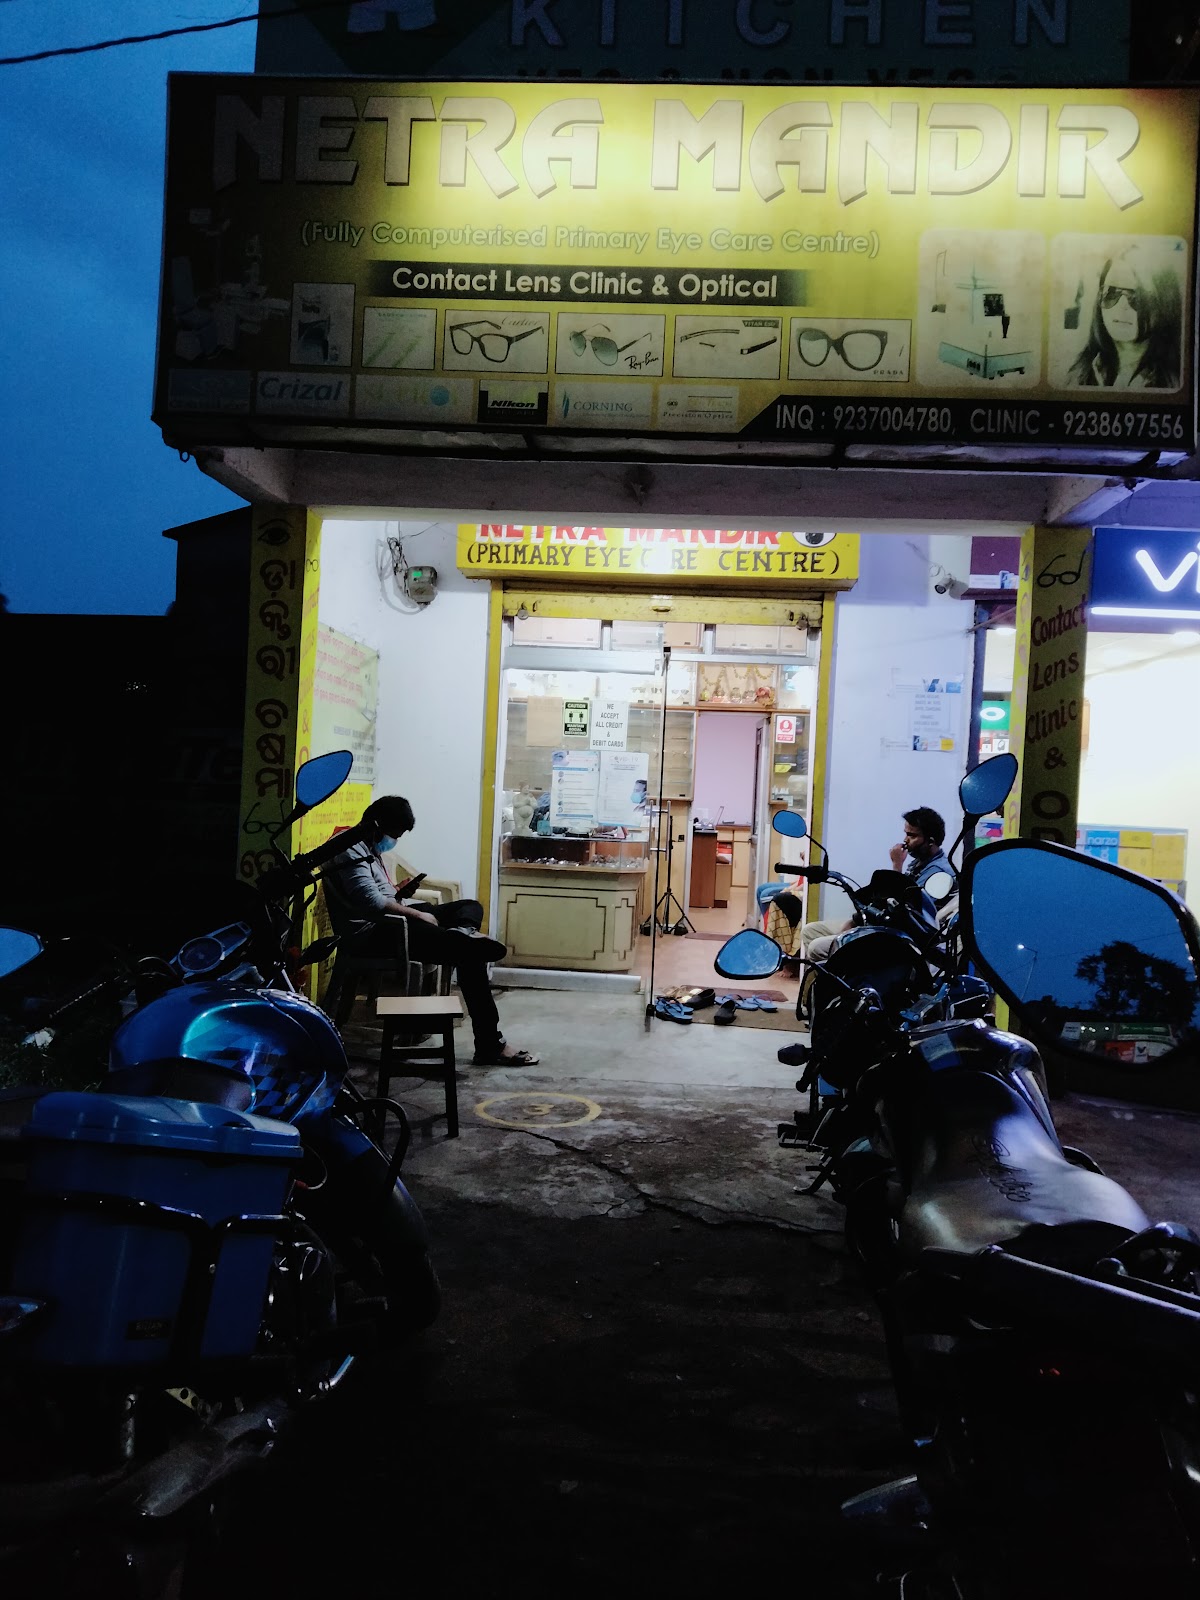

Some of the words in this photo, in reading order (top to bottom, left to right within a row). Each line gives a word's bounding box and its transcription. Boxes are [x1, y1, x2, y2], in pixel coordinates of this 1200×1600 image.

[211, 94, 604, 199] NETRA
[650, 99, 1144, 211] MANDIR
[301, 221, 365, 248] (Fully
[371, 222, 547, 249] Computerised
[555, 226, 649, 254] Primary
[656, 227, 702, 254] Eye
[710, 228, 773, 252] Care
[781, 229, 880, 259] Centre)
[392, 267, 498, 292] Contact
[505, 270, 561, 293] Lens
[569, 271, 643, 295] Clinic
[651, 274, 670, 296] &
[678, 273, 778, 302] Optical
[259, 377, 343, 401] Crizal
[490, 400, 536, 408] Nikon
[573, 400, 633, 412] CORNING
[776, 404, 815, 431] INQ
[970, 408, 1040, 435] CLINIC
[1063, 410, 1184, 439] 9238697556
[467, 542, 576, 567] (PRIMARY
[584, 546, 632, 568] EYE
[641, 548, 699, 571] CRE
[718, 549, 840, 575] CENTRE)
[1031, 594, 1087, 646] Contact
[1033, 652, 1079, 691] Lens
[605, 721, 623, 729] CREDIT
[1026, 699, 1077, 744] Clinic
[592, 739, 607, 747] DEBIT
[607, 740, 624, 748] CARDS
[1044, 747, 1067, 770] &
[1087, 836, 1118, 845] narzo
